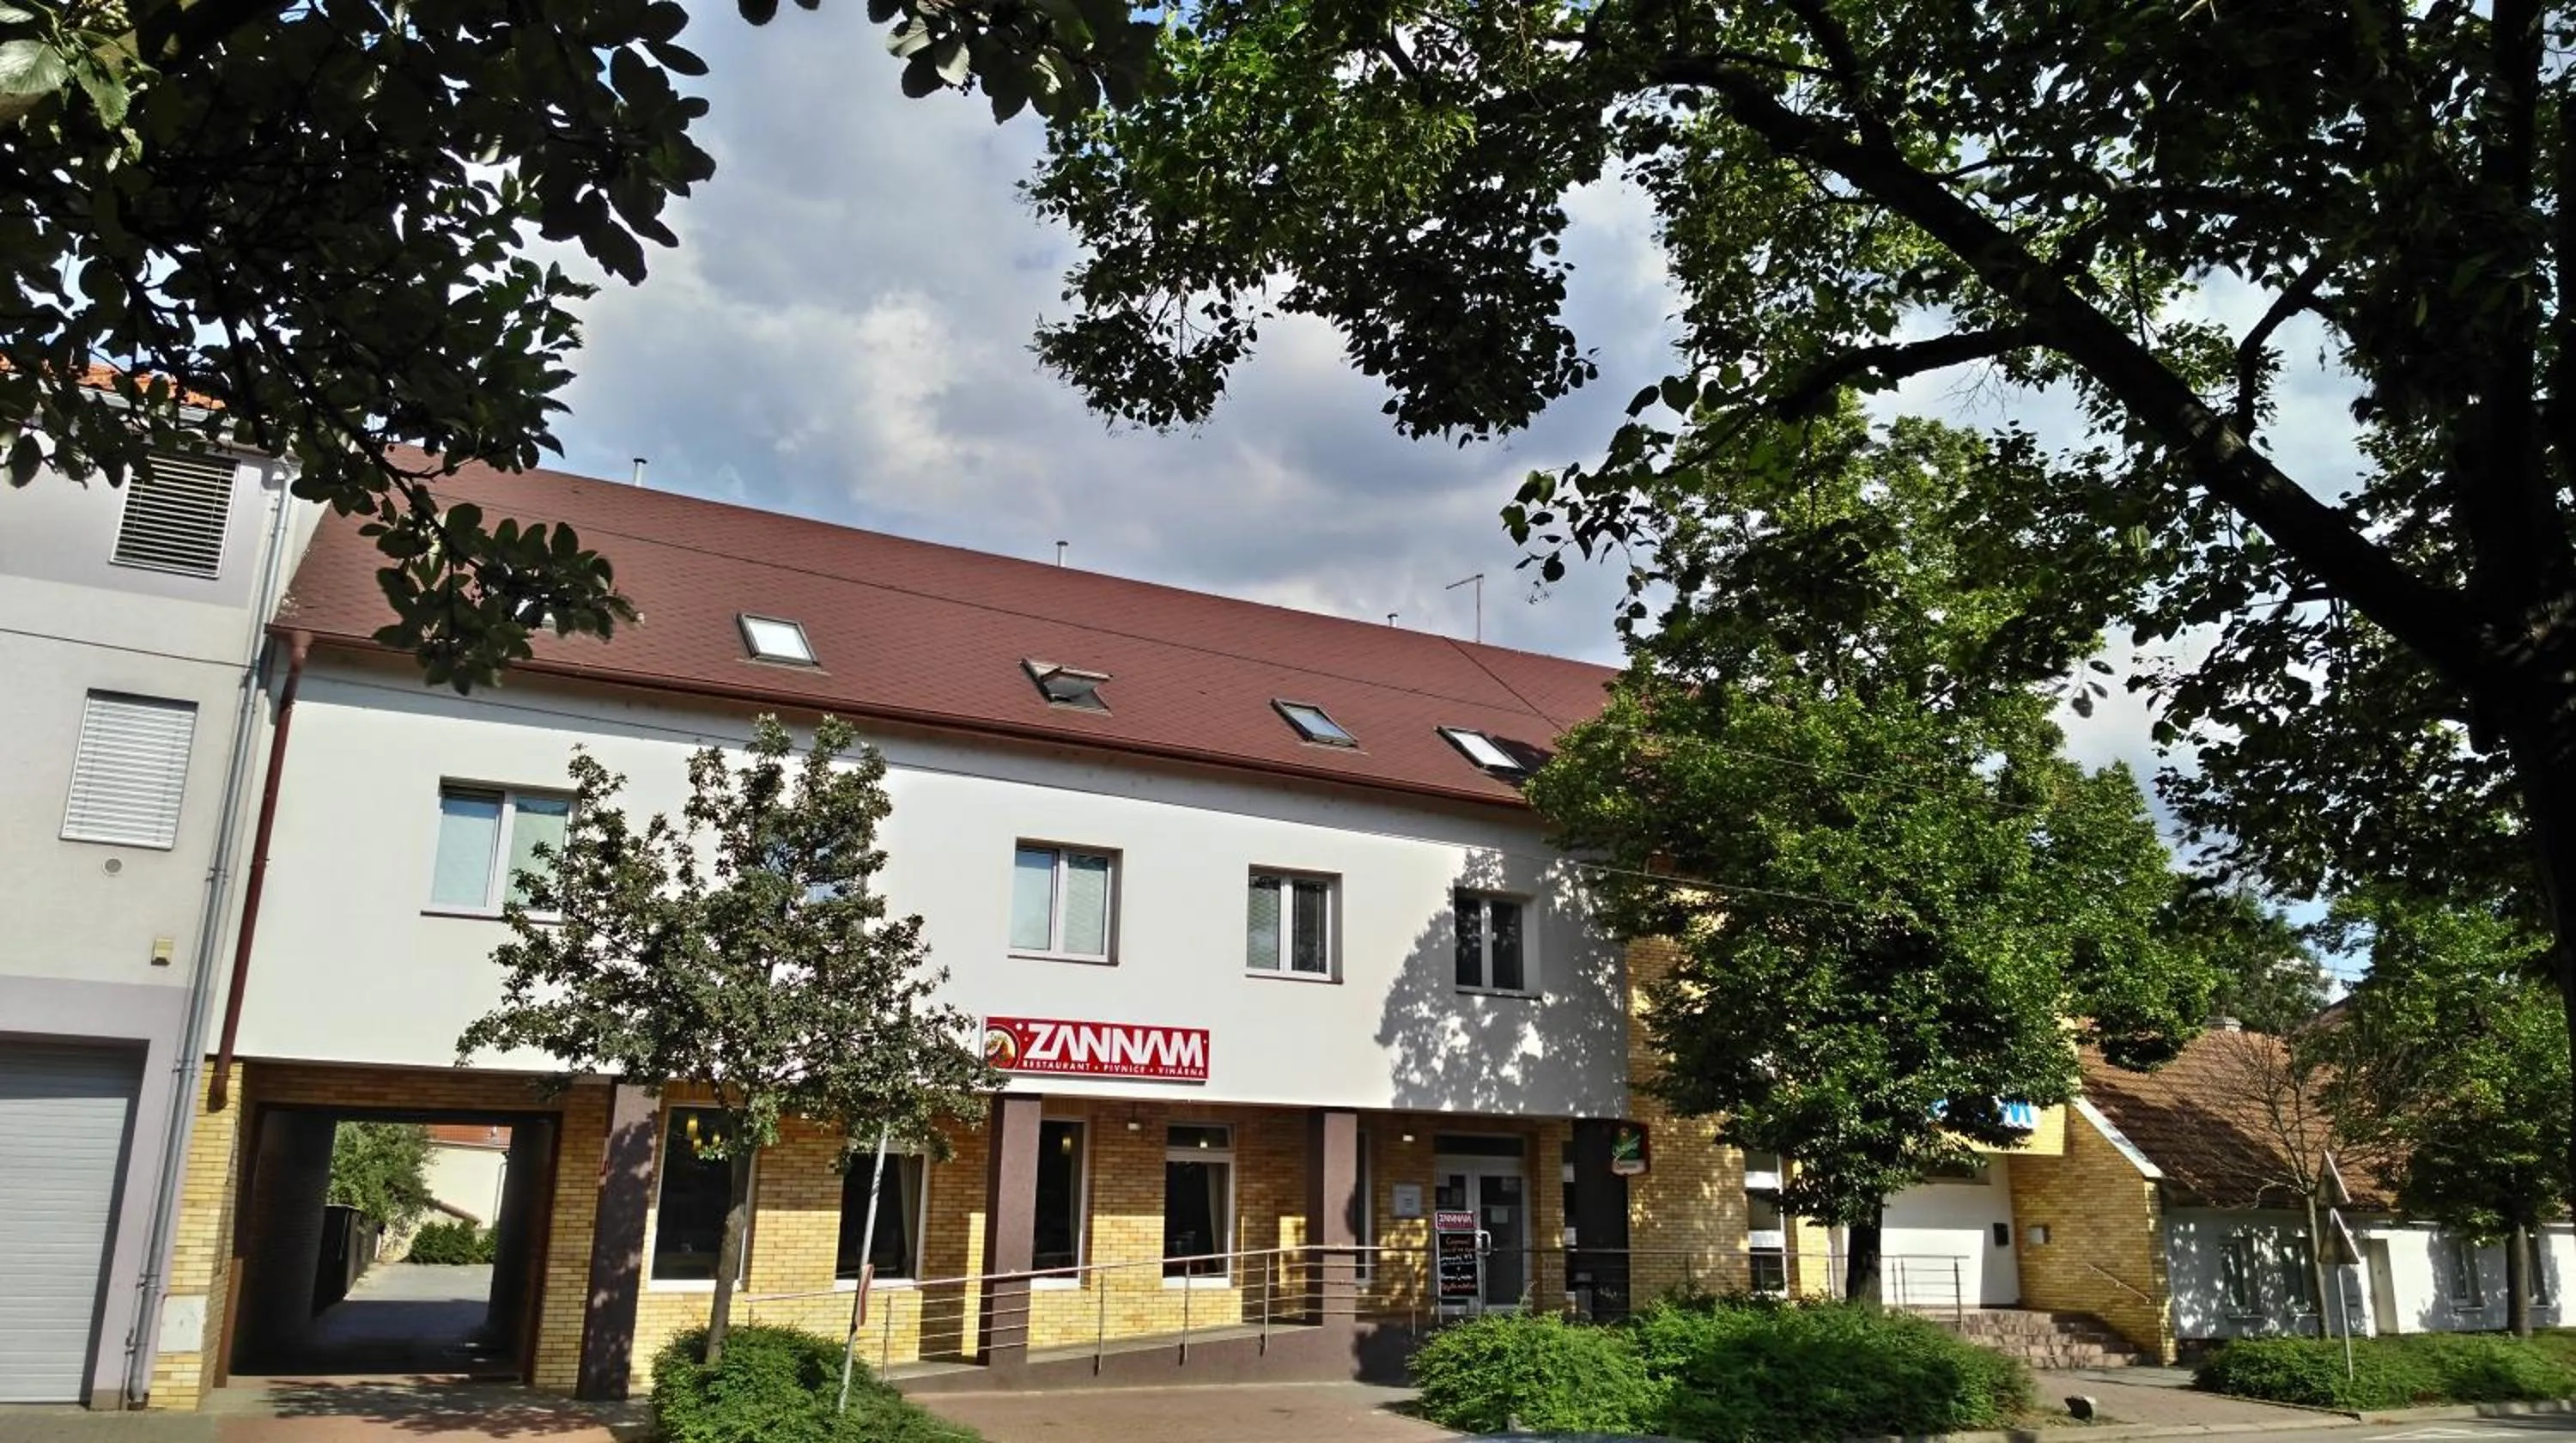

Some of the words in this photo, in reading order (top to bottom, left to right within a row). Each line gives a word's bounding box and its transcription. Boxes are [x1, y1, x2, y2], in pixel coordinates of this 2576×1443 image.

[1024, 1023, 1204, 1068] ZANNAM
[1023, 1059, 1091, 1071] RESTAURANT
[1103, 1064, 1145, 1075] PIVNICE
